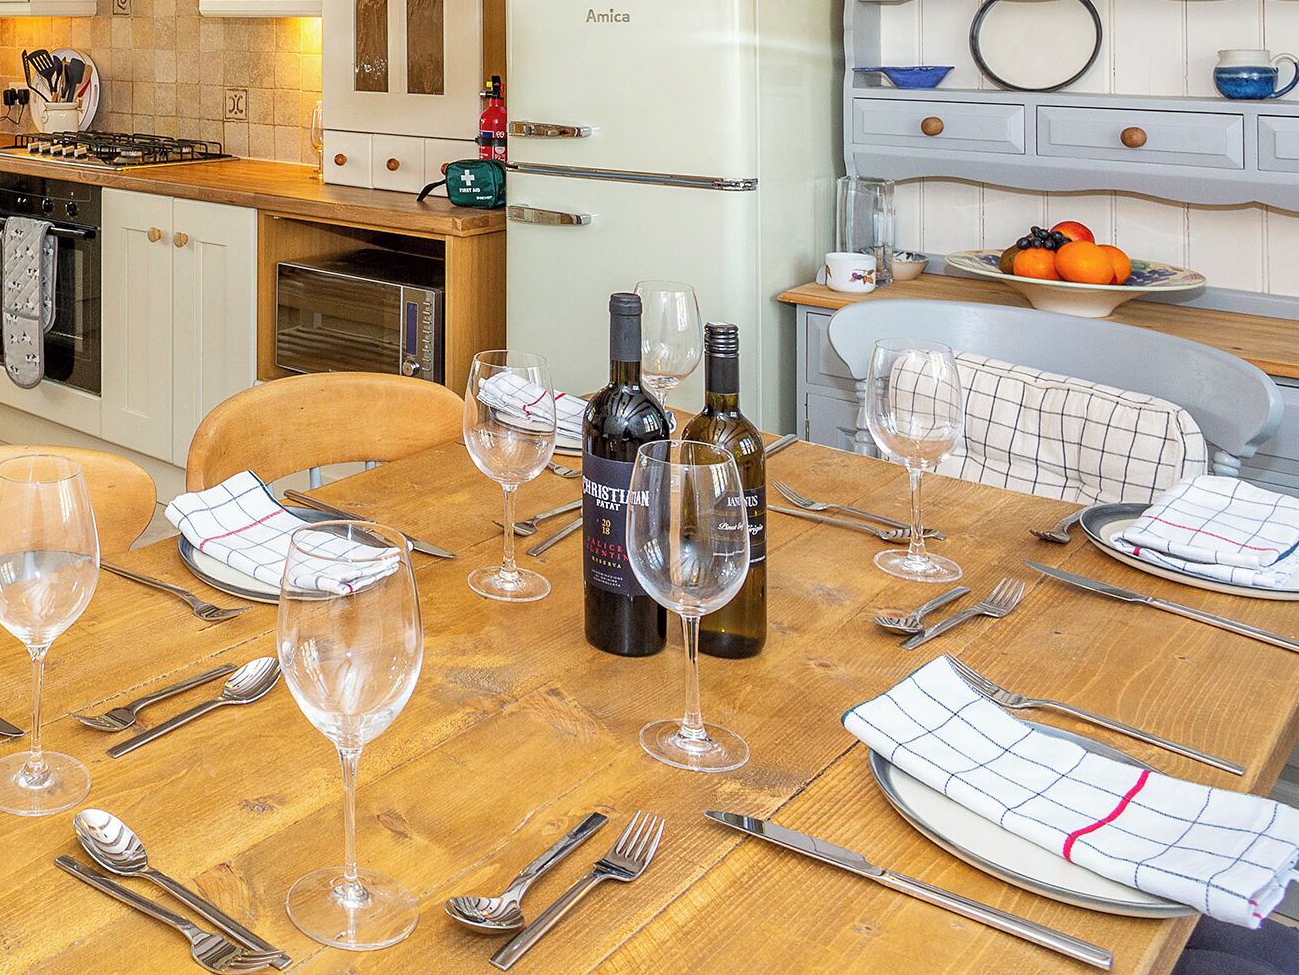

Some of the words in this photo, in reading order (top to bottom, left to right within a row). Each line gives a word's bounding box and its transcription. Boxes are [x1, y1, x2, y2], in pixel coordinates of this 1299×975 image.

[585, 8, 631, 23] Amica
[596, 498, 621, 511] PATAT
[602, 518, 611, 528] 20
[602, 526, 611, 536] 18
